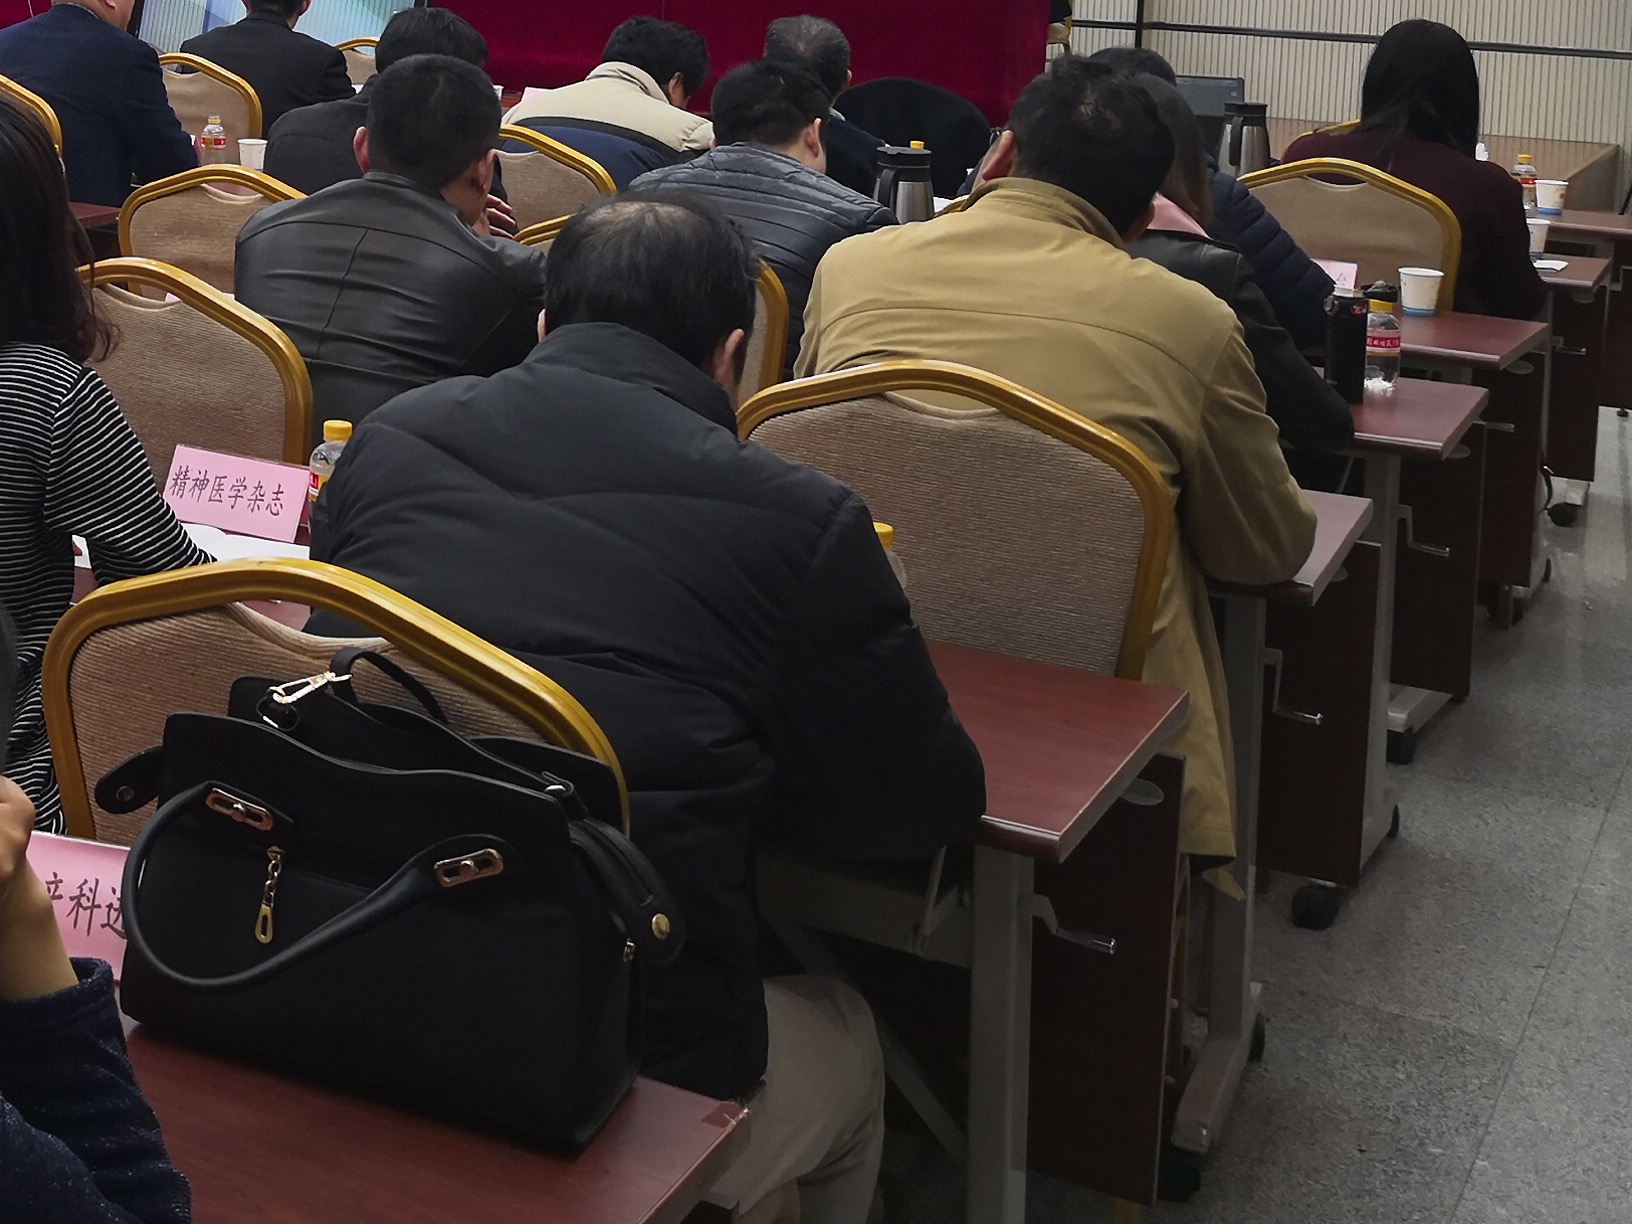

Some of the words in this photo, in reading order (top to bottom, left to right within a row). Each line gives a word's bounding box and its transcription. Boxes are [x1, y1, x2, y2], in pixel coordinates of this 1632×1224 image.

[169, 465, 284, 517] 精神医学杂志
